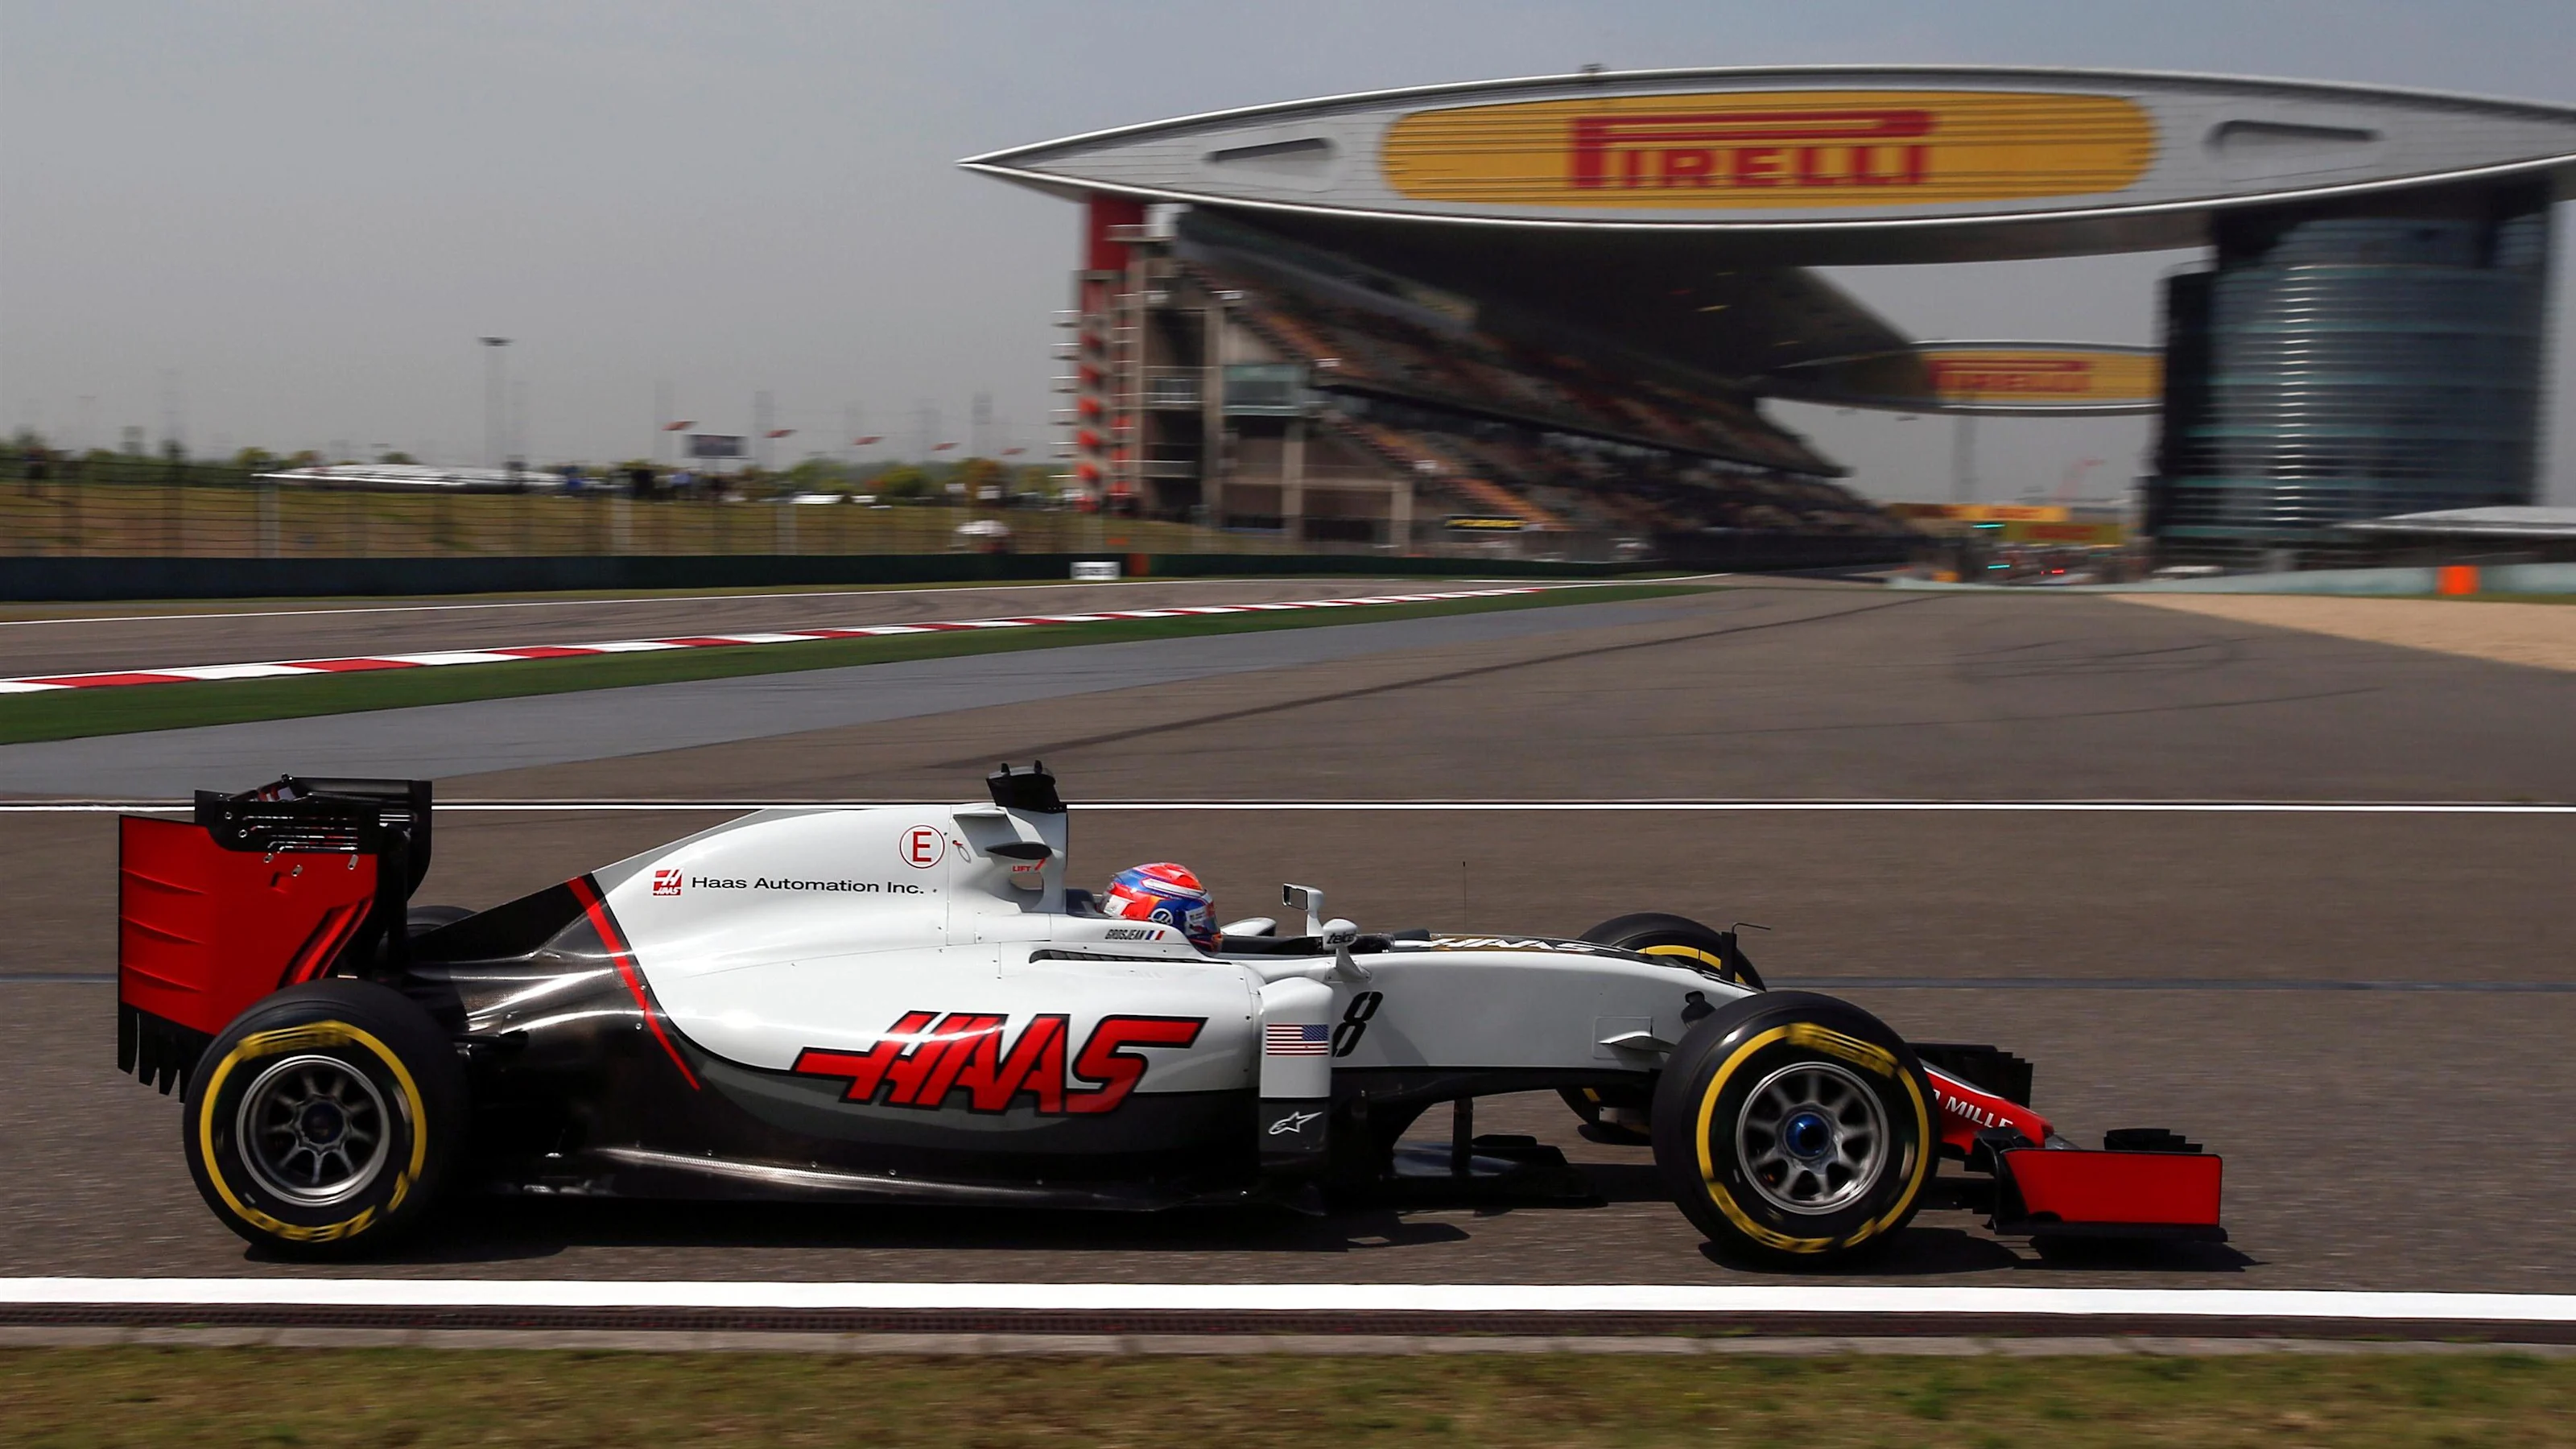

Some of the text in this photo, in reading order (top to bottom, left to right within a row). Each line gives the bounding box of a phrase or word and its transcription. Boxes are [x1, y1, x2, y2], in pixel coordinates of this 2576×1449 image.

[1573, 109, 1934, 188] PIRELLI
[913, 831, 931, 862] E
[652, 886, 682, 895] HAAS
[692, 877, 924, 894] Haas Automation Inc.
[1104, 929, 1146, 940] GROSJEAN
[1419, 938, 1621, 952] HAAS
[1331, 991, 1384, 1058] 8
[789, 1010, 1209, 1117] HAAS
